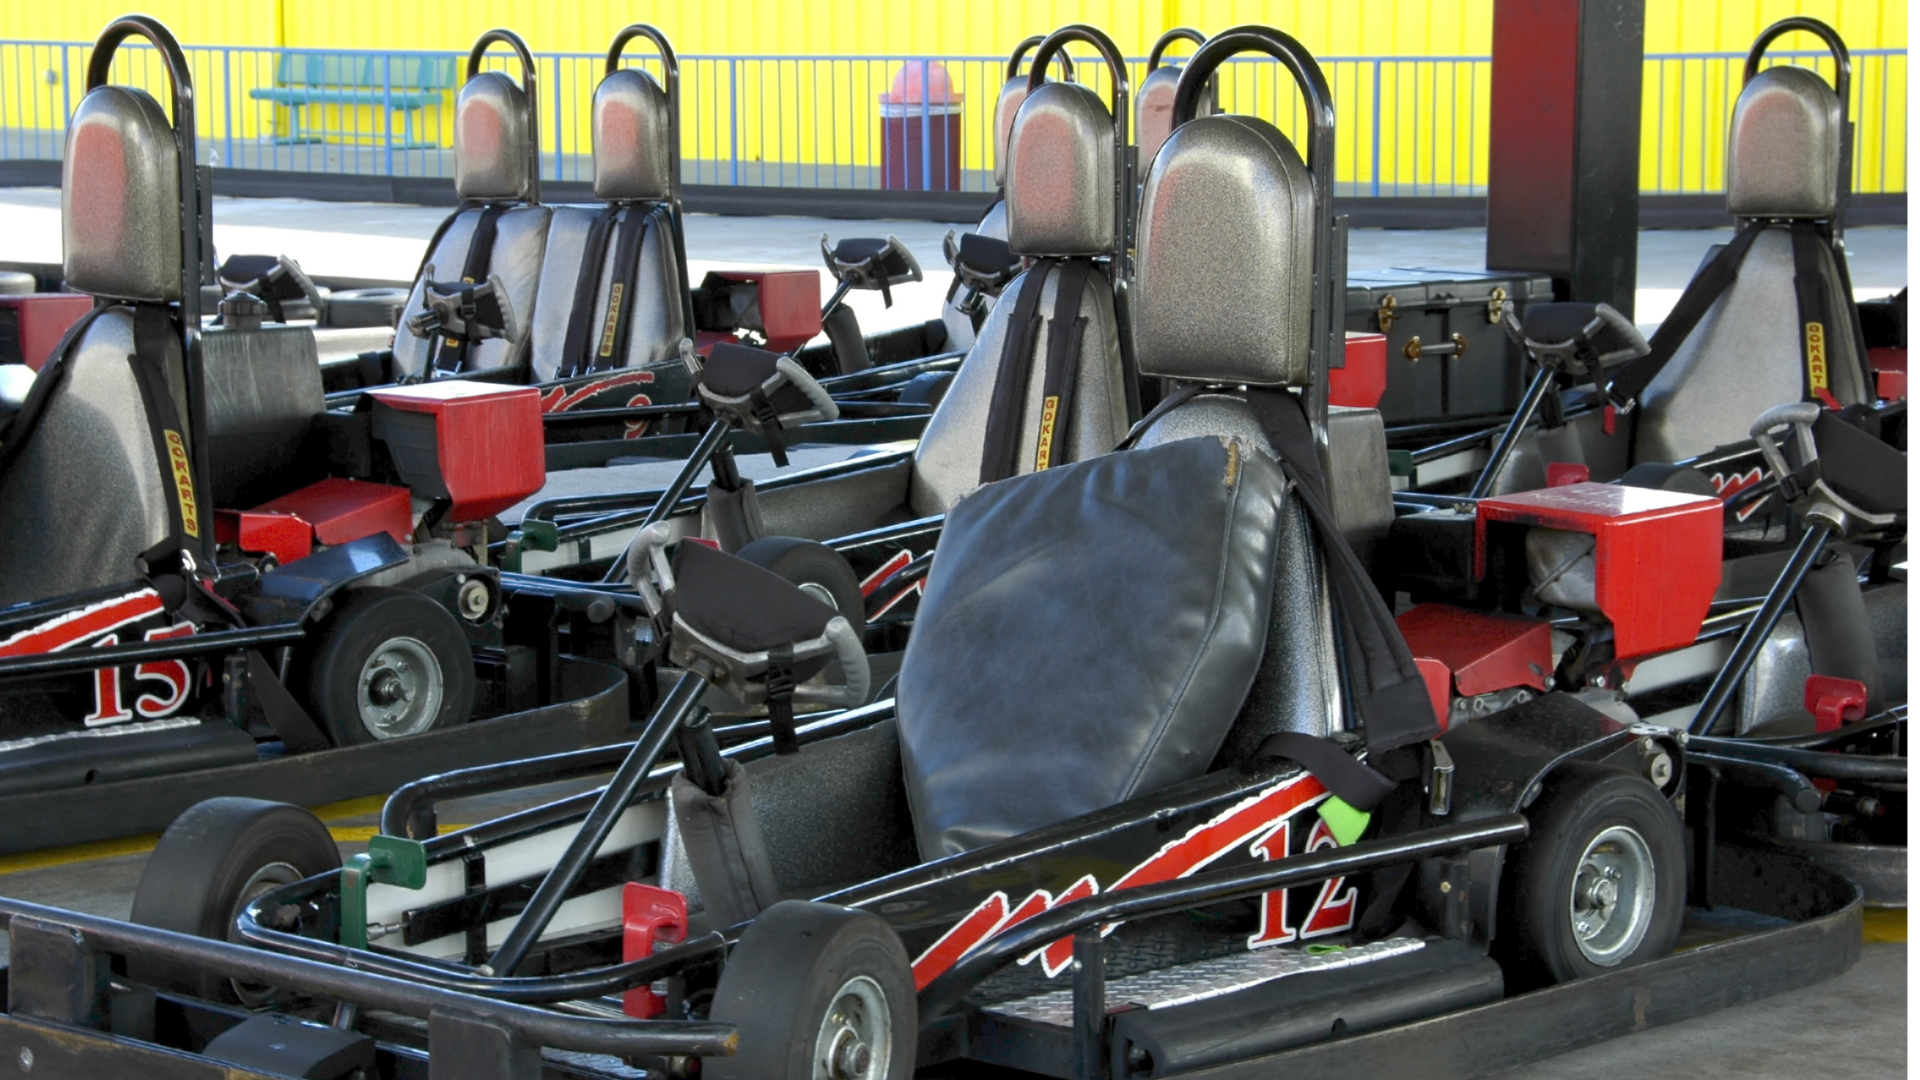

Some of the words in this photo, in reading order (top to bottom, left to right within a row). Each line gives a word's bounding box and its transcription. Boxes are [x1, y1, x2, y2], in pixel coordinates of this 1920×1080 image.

[602, 285, 622, 354] GOKARTS
[168, 432, 197, 532] GOKARTS
[1038, 399, 1055, 471] GOKART
[84, 620, 191, 727] 15
[1247, 816, 1358, 950] 12
